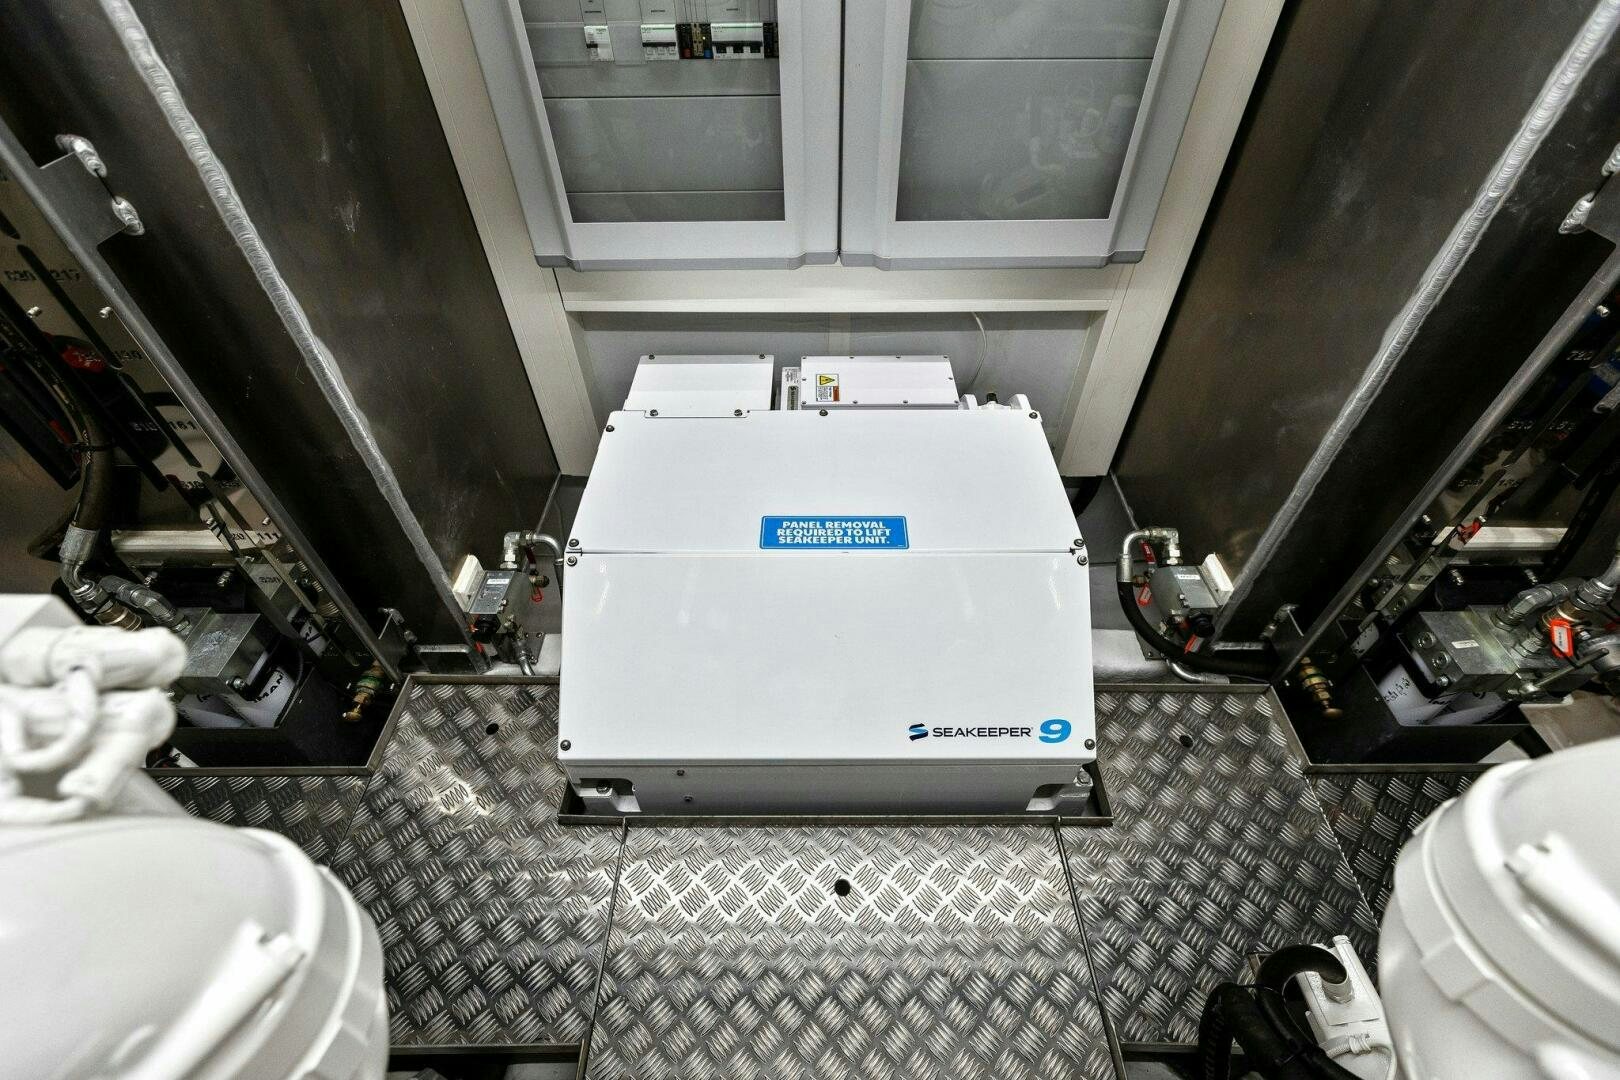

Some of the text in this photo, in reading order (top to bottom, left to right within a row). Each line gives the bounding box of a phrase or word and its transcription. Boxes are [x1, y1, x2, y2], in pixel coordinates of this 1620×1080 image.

[782, 521, 886, 529] PANEL REMOVAL
[776, 528, 892, 537] REQUIRED TO LIFT
[778, 536, 890, 544] SEAKEEPER UNIT.
[932, 718, 1072, 744] SEAKEEPER 9
